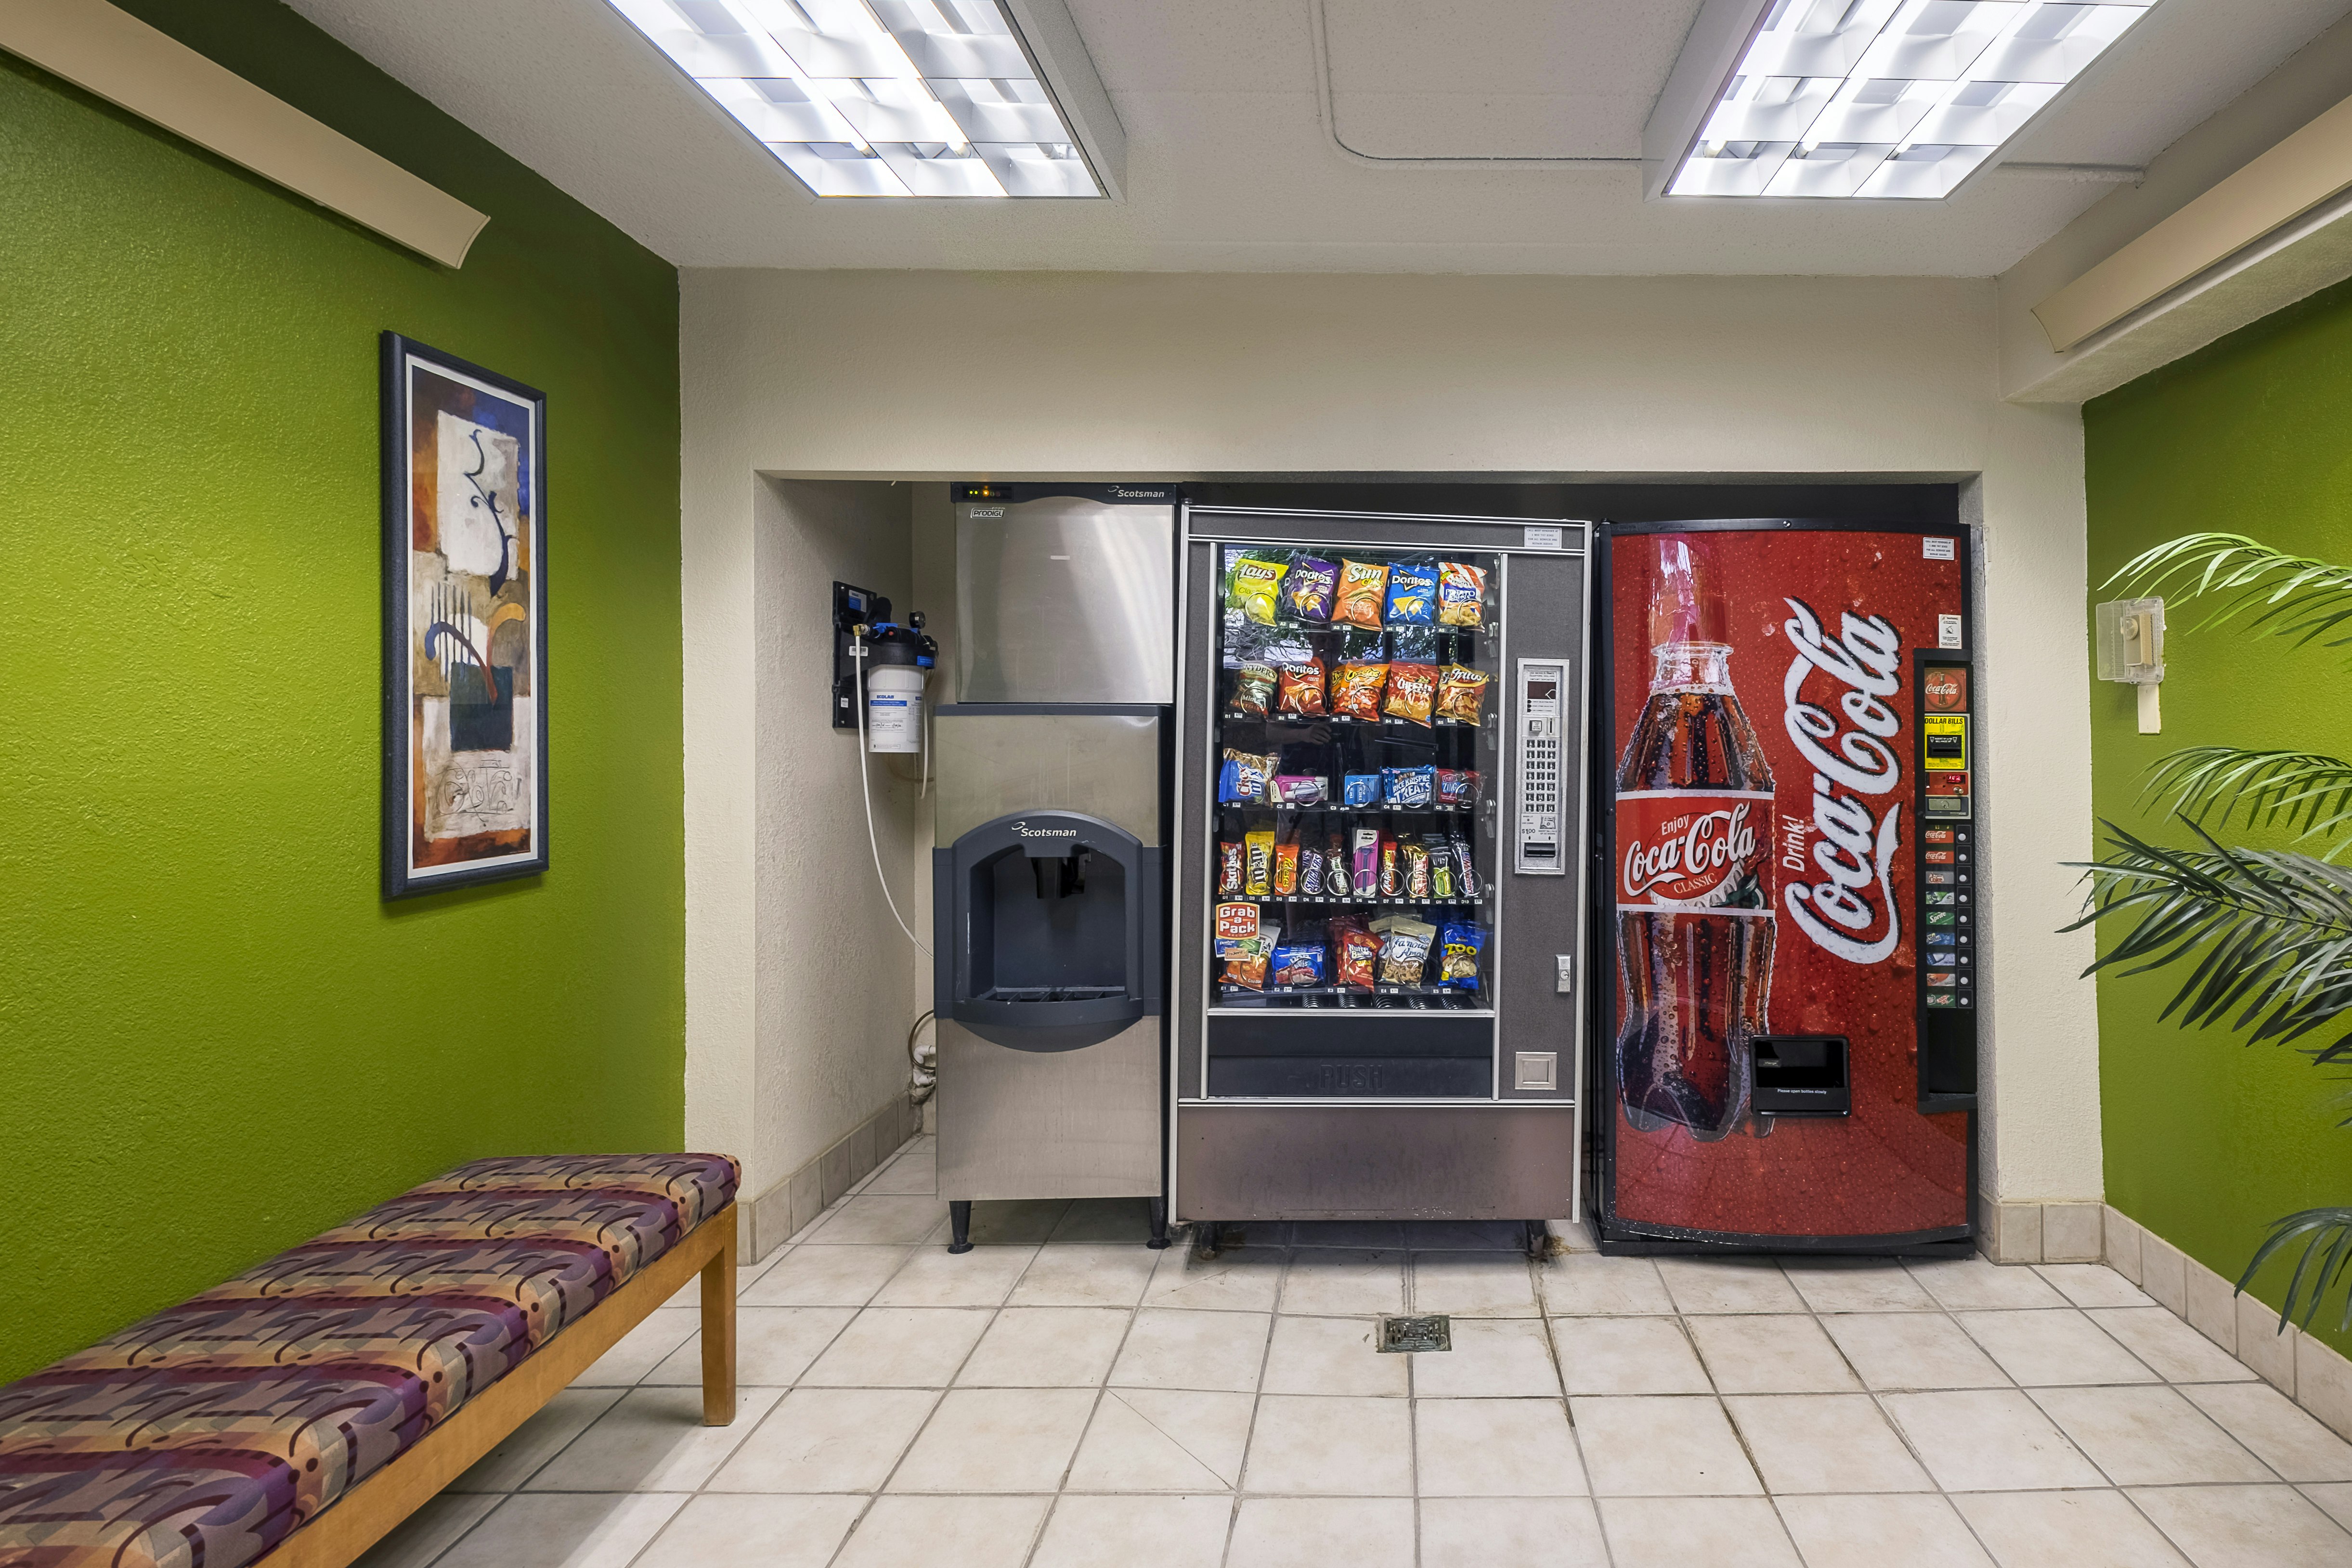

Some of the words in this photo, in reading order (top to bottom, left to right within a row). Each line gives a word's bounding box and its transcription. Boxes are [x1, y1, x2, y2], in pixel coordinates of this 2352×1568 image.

[1348, 565, 1382, 583] Sun
[1392, 575, 1431, 586] Doritos
[1283, 662, 1320, 675] Doritos
[1452, 668, 1482, 681] Fritos
[1925, 683, 1958, 694] Coca-Cola
[1393, 782, 1404, 792] RICE
[1405, 775, 1430, 785] KRISPIES
[1785, 597, 1901, 964] Coca-Cola
[1394, 782, 1430, 803] TREATS
[1021, 828, 1077, 837] Scotsman
[1661, 815, 1689, 836] Enjoy
[1624, 801, 1755, 896] Coca-Cola
[1784, 815, 1806, 873] Drink!
[1305, 854, 1323, 892] SNICKERS
[1674, 873, 1717, 894] CLASSIC
[1220, 907, 1255, 918] Grab
[1930, 912, 1947, 924] Sprite
[1220, 920, 1255, 934] Pack
[1393, 937, 1428, 950] Famous
[1444, 943, 1477, 956] ZOO
[1396, 947, 1427, 959] Amos
[1320, 1063, 1383, 1089] PUSH
